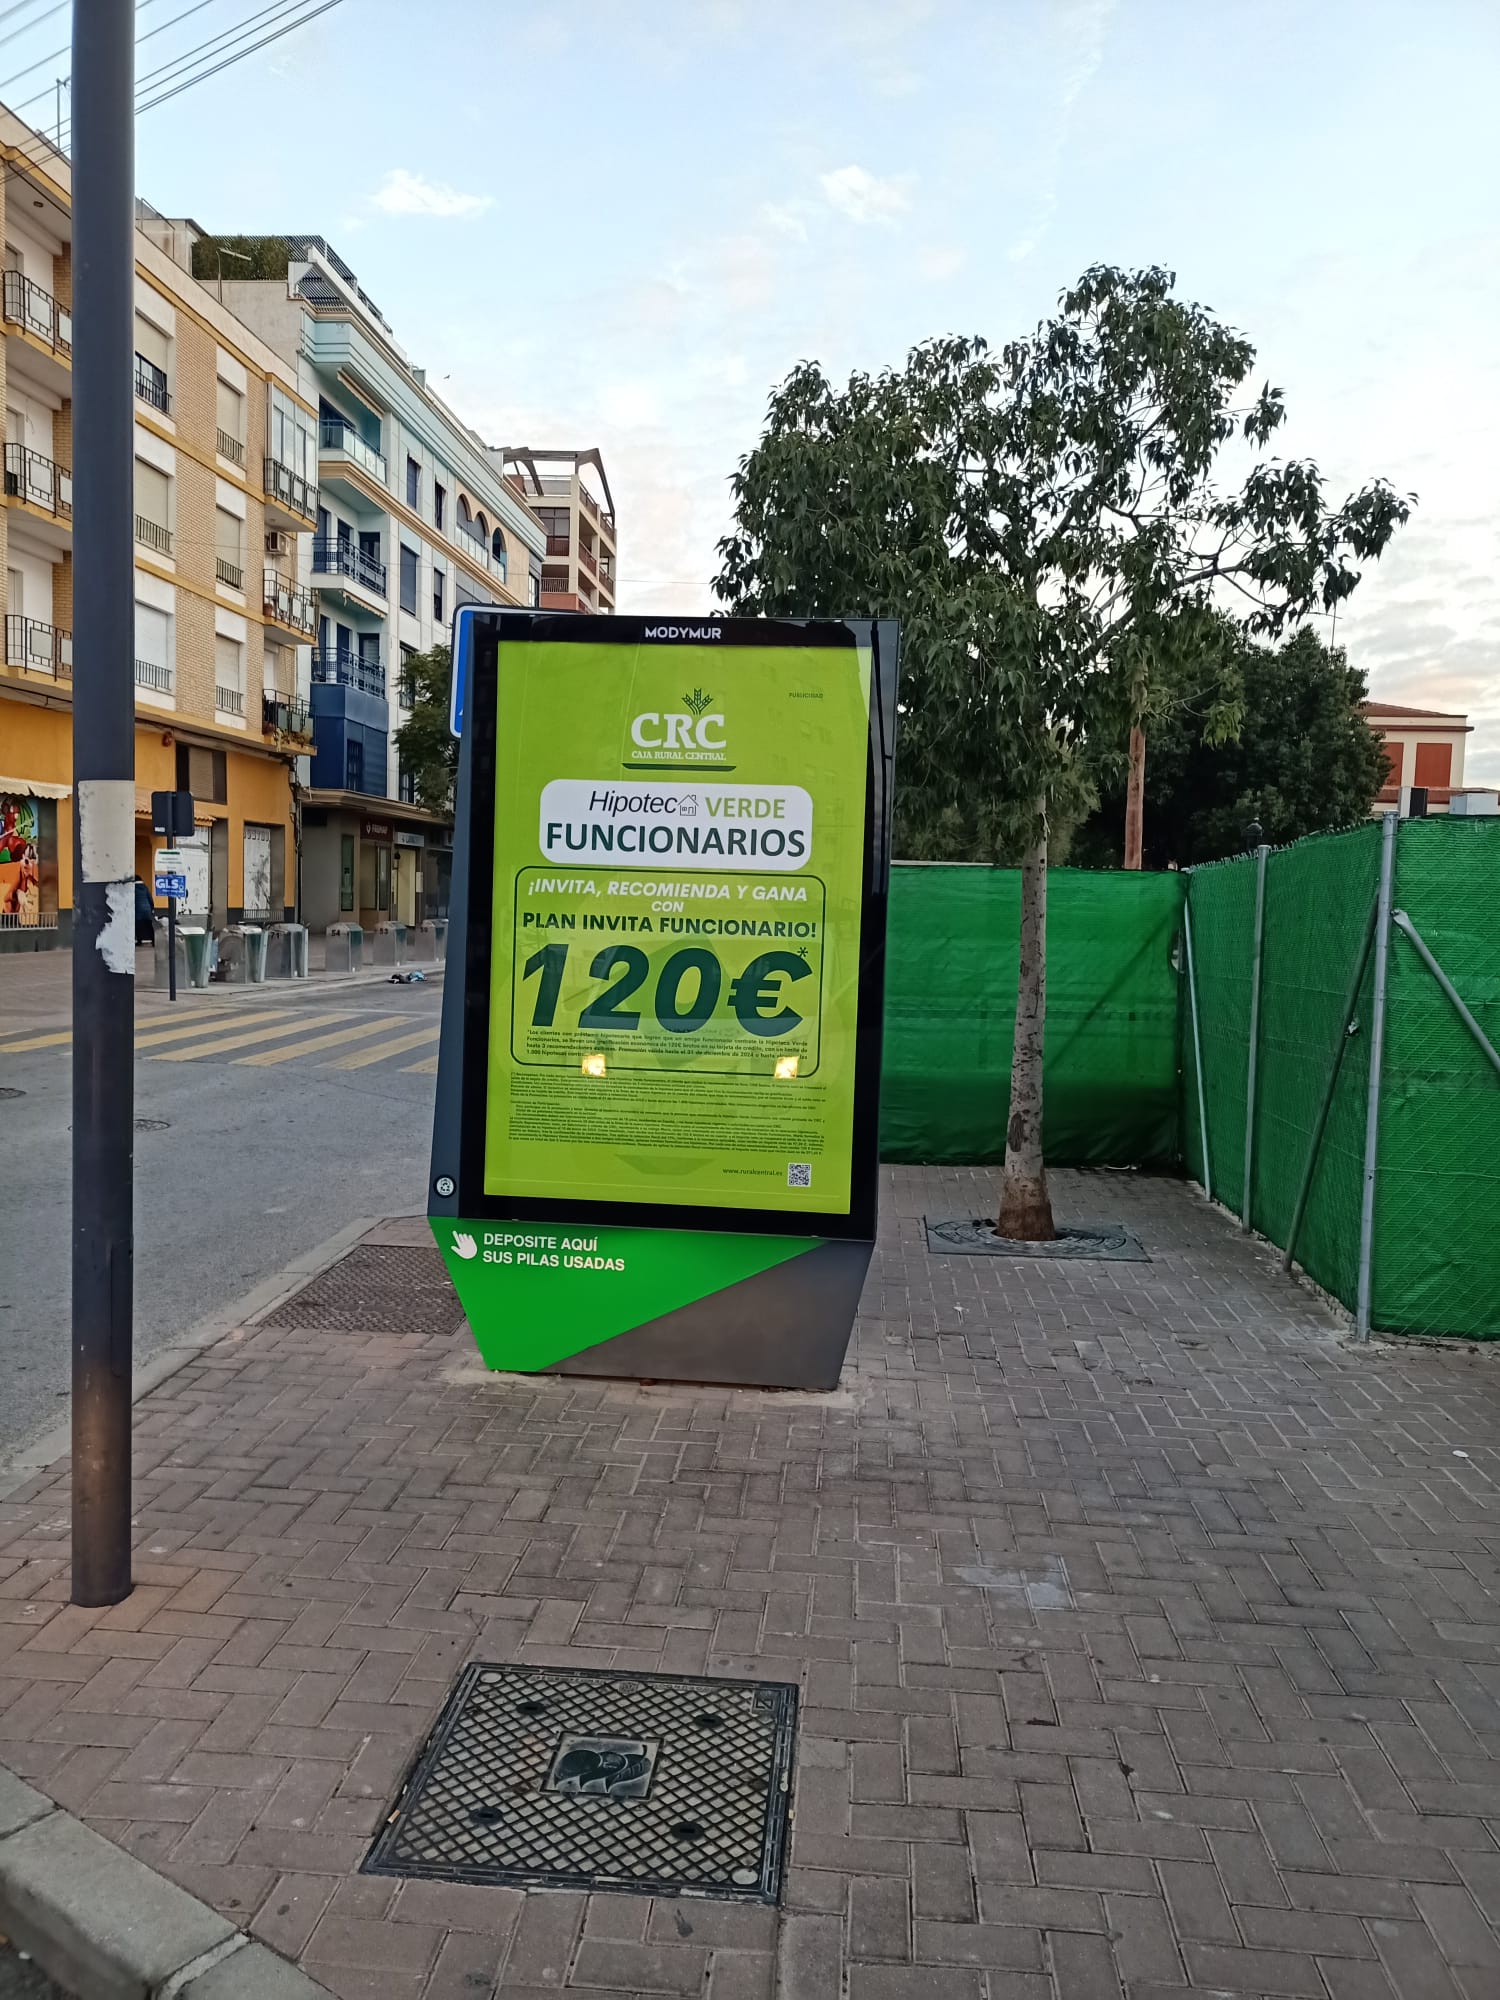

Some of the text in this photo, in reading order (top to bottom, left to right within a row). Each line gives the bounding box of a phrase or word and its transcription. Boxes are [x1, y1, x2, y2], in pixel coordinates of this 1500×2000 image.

[645, 627, 722, 639] MODYMUR
[631, 712, 727, 750] CRC
[631, 751, 727, 761] CAJA RURAL CENTRAL
[705, 797, 786, 819] VERDE
[546, 822, 806, 858] FUNCIONARIOS
[156, 878, 179, 889] GLS
[528, 878, 808, 901] ¡INVITA, RECOMIENDA Y GANA
[651, 901, 684, 913] CON
[522, 912, 817, 938] PLAN INVITA FUNCIONARIO!
[483, 1233, 598, 1252] DEPOSITE AQUÍ
[482, 1250, 625, 1272] SUS PILAS USADAS
